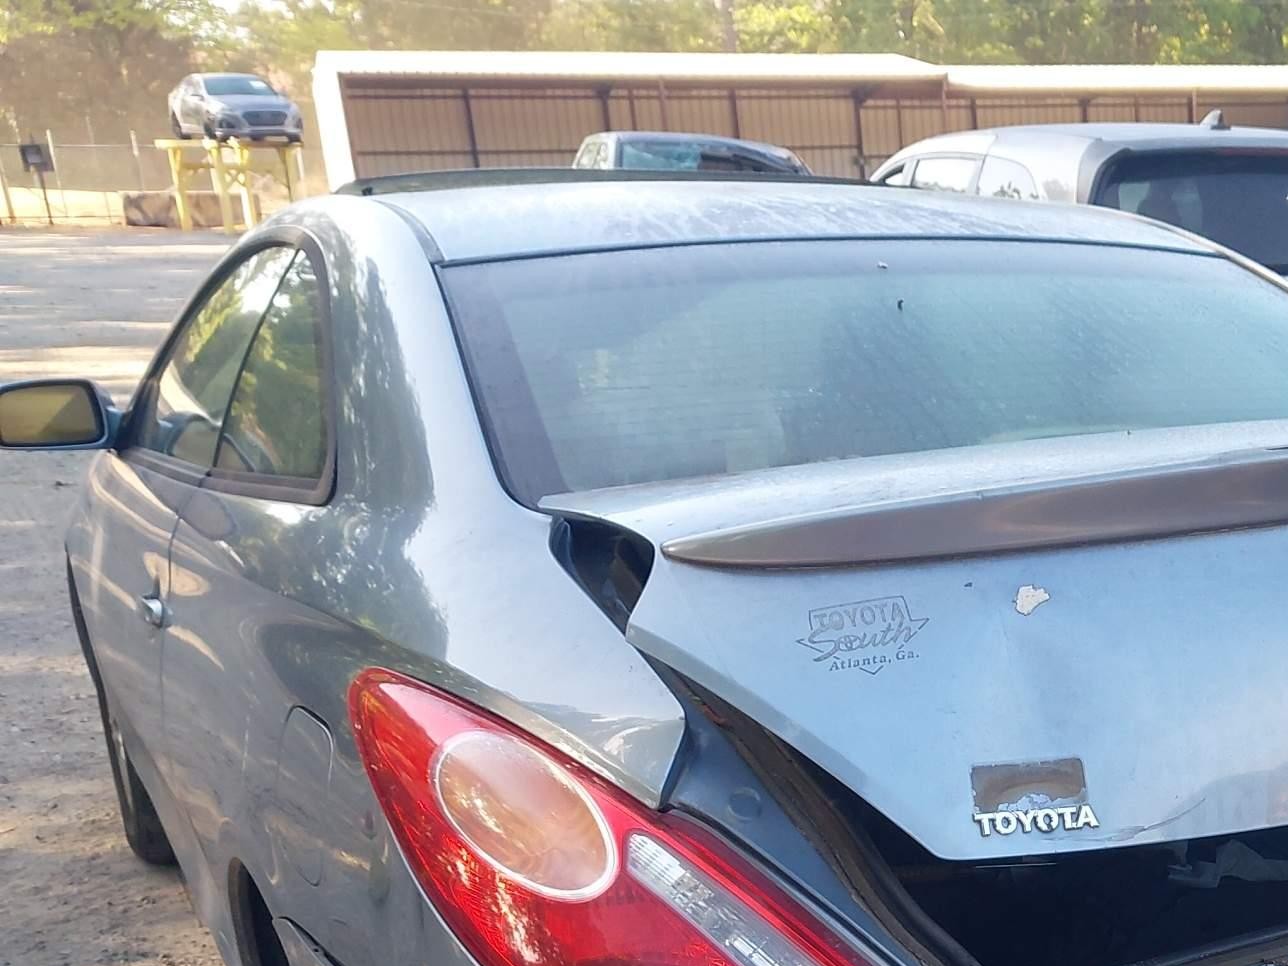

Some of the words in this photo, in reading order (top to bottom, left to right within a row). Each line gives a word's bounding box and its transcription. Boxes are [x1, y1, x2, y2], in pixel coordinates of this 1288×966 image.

[812, 601, 905, 631] TOYOTA
[807, 622, 914, 662] South
[828, 654, 892, 672] Atlanta,
[895, 648, 920, 661] Ga.
[972, 803, 1100, 837] TOYOTA
